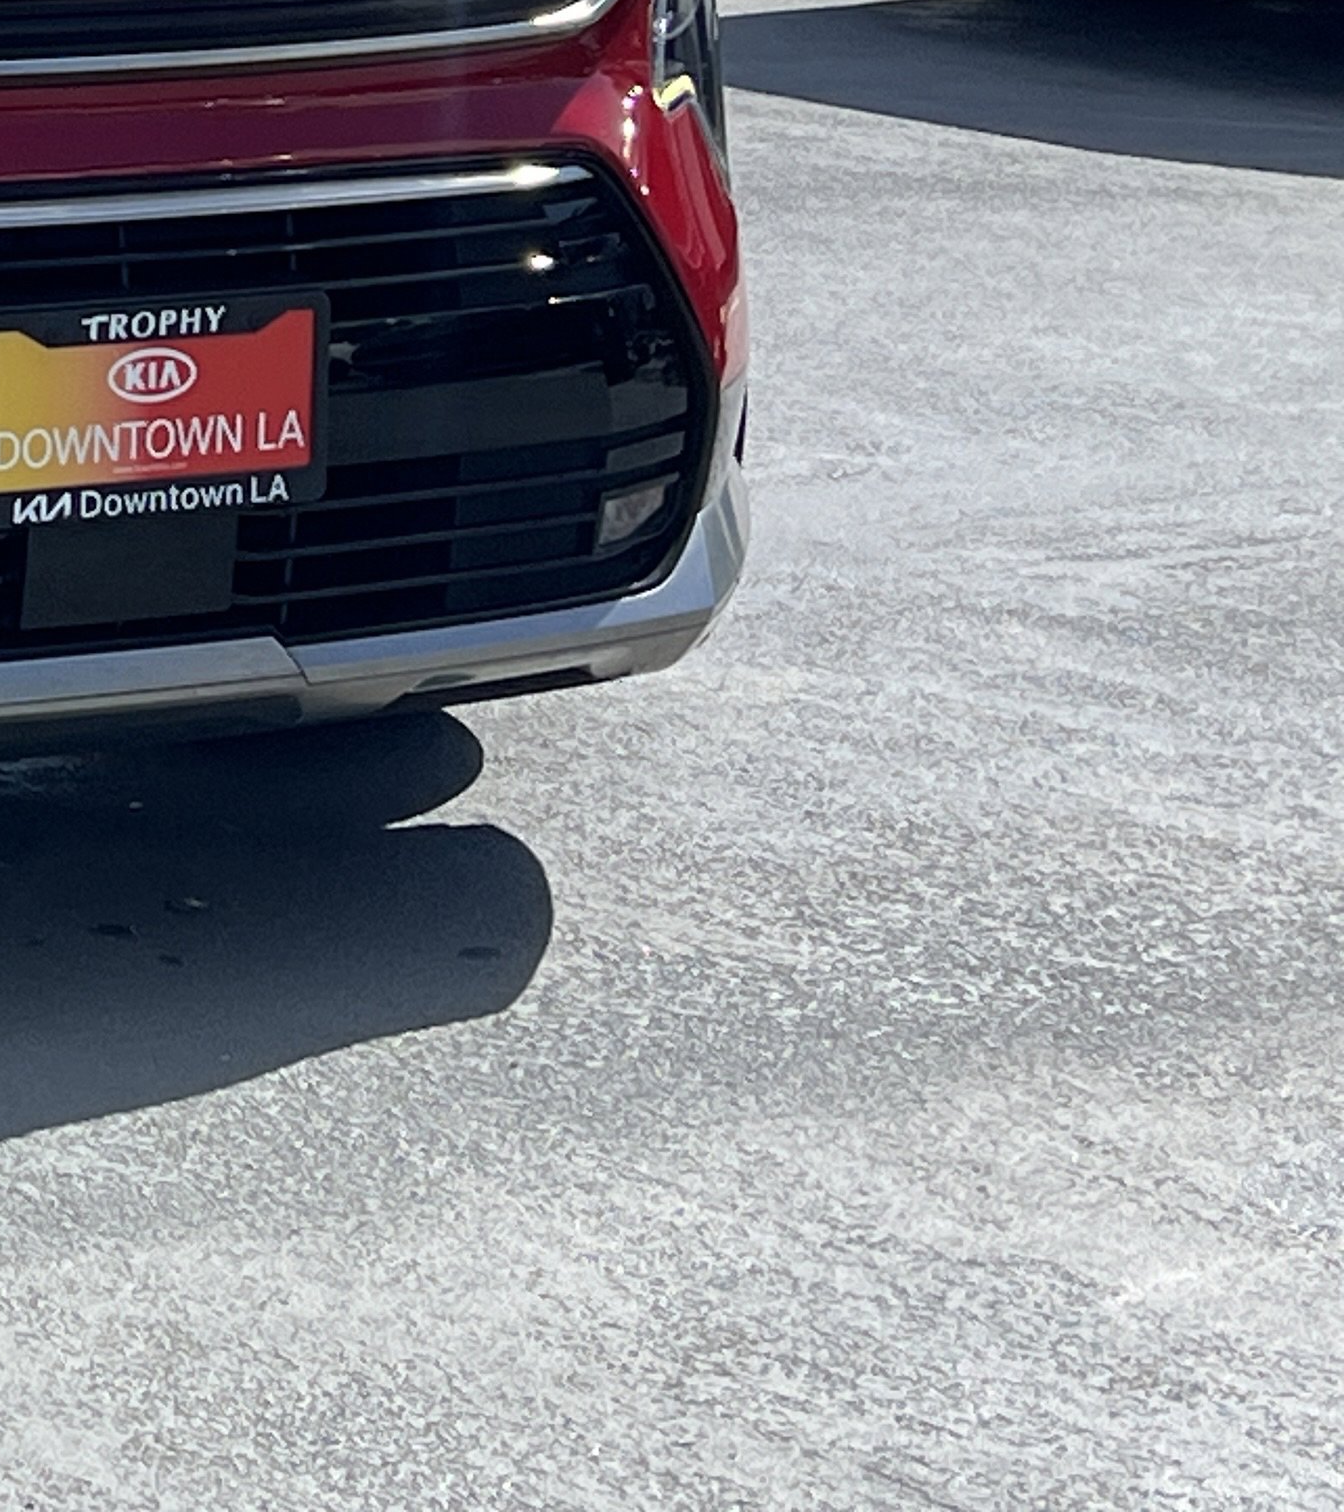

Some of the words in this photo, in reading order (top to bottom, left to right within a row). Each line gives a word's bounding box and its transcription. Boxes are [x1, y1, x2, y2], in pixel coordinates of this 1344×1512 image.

[81, 304, 227, 341] TROPHY
[123, 359, 182, 391] KIA
[256, 409, 306, 451] LA
[12, 490, 73, 525] KIA
[79, 482, 243, 519] Downtown
[249, 474, 290, 504] LA
